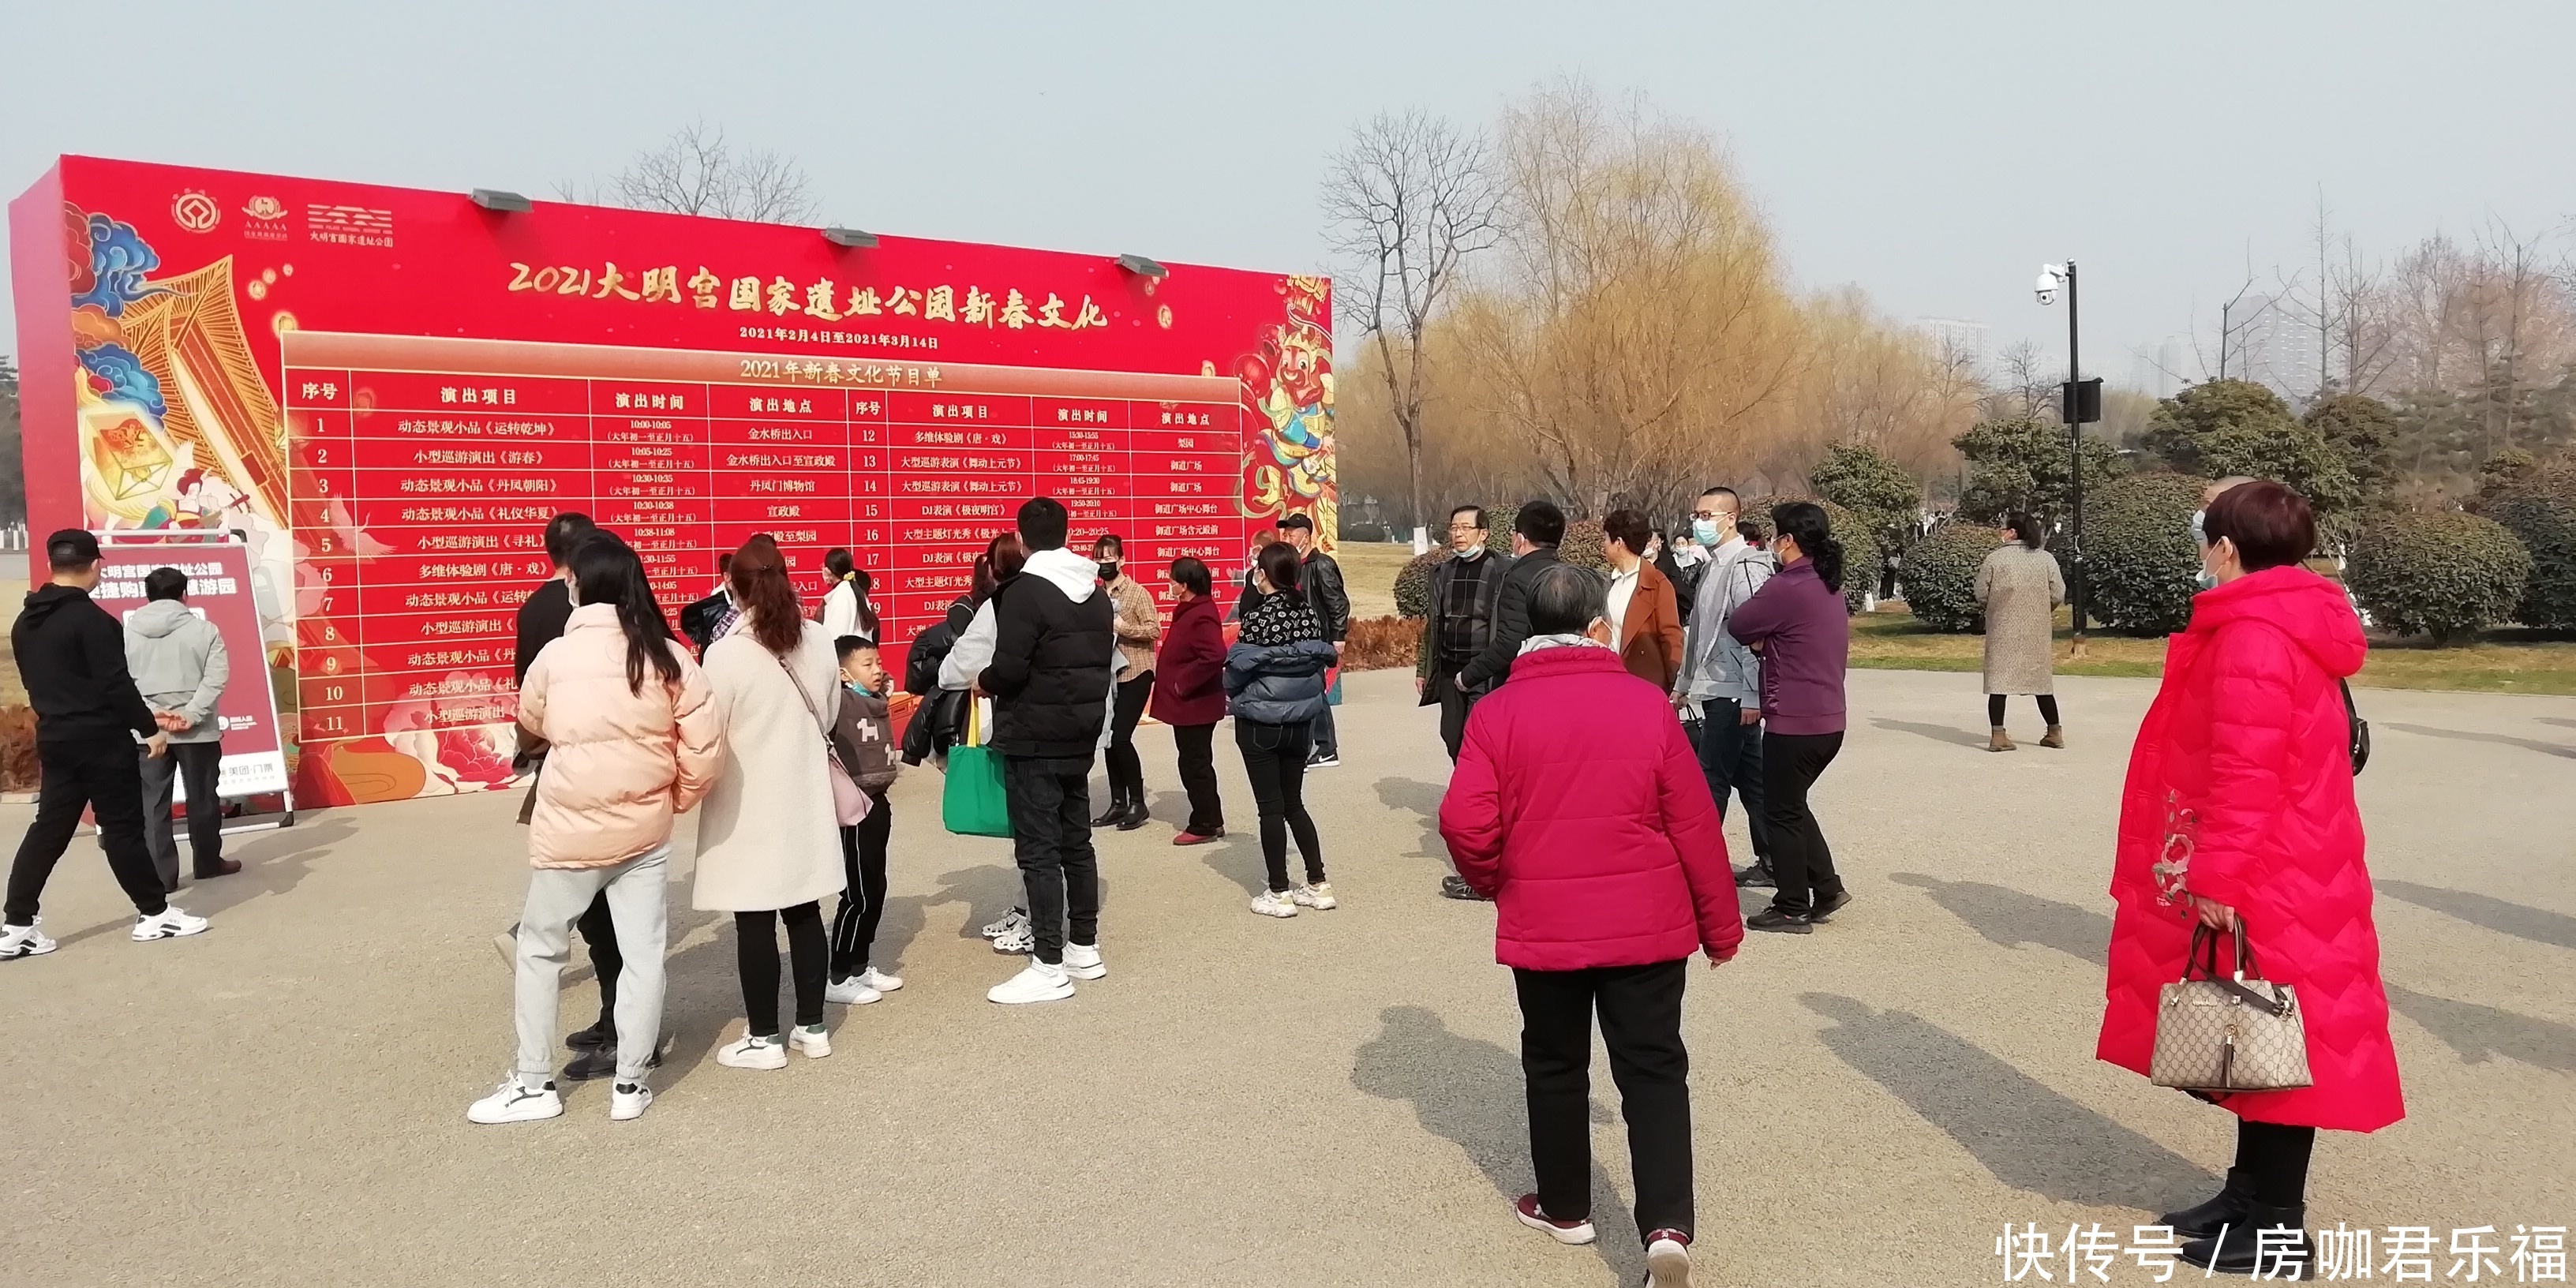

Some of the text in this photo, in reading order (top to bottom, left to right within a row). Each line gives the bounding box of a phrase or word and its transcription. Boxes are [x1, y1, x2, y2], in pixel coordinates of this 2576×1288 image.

[508, 261, 1109, 330] 2021大明宫国家遗址公园新春文化
[739, 326, 939, 350] 2021年2月4日至2021年3月14日
[740, 359, 943, 388] 2021年新春文化节目单
[302, 383, 338, 401] 序号
[440, 387, 516, 405] 演出项目
[616, 392, 684, 410] 演出时间
[749, 397, 813, 414] 演出地点
[856, 401, 881, 416] 序号
[932, 403, 988, 419] 演出项目
[1058, 408, 1108, 424] 演出时间
[317, 417, 325, 433] 1
[630, 420, 672, 429] 10:00-10:05
[1161, 412, 1210, 426] 演出地点
[398, 419, 556, 436] 动态景观小品《运转乾坤》
[747, 427, 813, 440] 金水桥出入口
[863, 429, 875, 442] 12
[317, 449, 328, 464] 2
[413, 449, 545, 466] 小型巡游演出《游春》
[631, 447, 672, 457] 10:05-10:25
[726, 453, 836, 467] 金水桥出入口至宣政殿
[863, 455, 876, 468] 13
[900, 455, 1022, 470] 大型巡游表演《舞动上元节》
[1170, 460, 1203, 471] 御道广场
[319, 478, 328, 494] 3
[400, 478, 558, 493] 动态景观小品《丹凤朝阳》
[631, 474, 673, 484] 10:30-10:35
[750, 480, 815, 493] 丹凤门博物馆
[864, 480, 877, 492] 14
[902, 480, 1023, 493] 大型巡游表演《舞动上元节》
[1170, 481, 1202, 492] 御道广场
[320, 507, 330, 522] 4
[766, 505, 800, 518] 宣政殿
[865, 504, 878, 517] 15
[922, 504, 1006, 517] DJ表演《极夜明宫》
[1155, 503, 1218, 515] 御道广场中心舞台
[866, 529, 879, 541] 16
[321, 537, 331, 552] 5
[867, 552, 879, 566] 17
[322, 567, 333, 582] 6
[324, 597, 333, 612] 7
[325, 626, 335, 641] 8
[326, 656, 337, 672] 9
[325, 685, 343, 701] 10
[327, 715, 343, 731] 11
